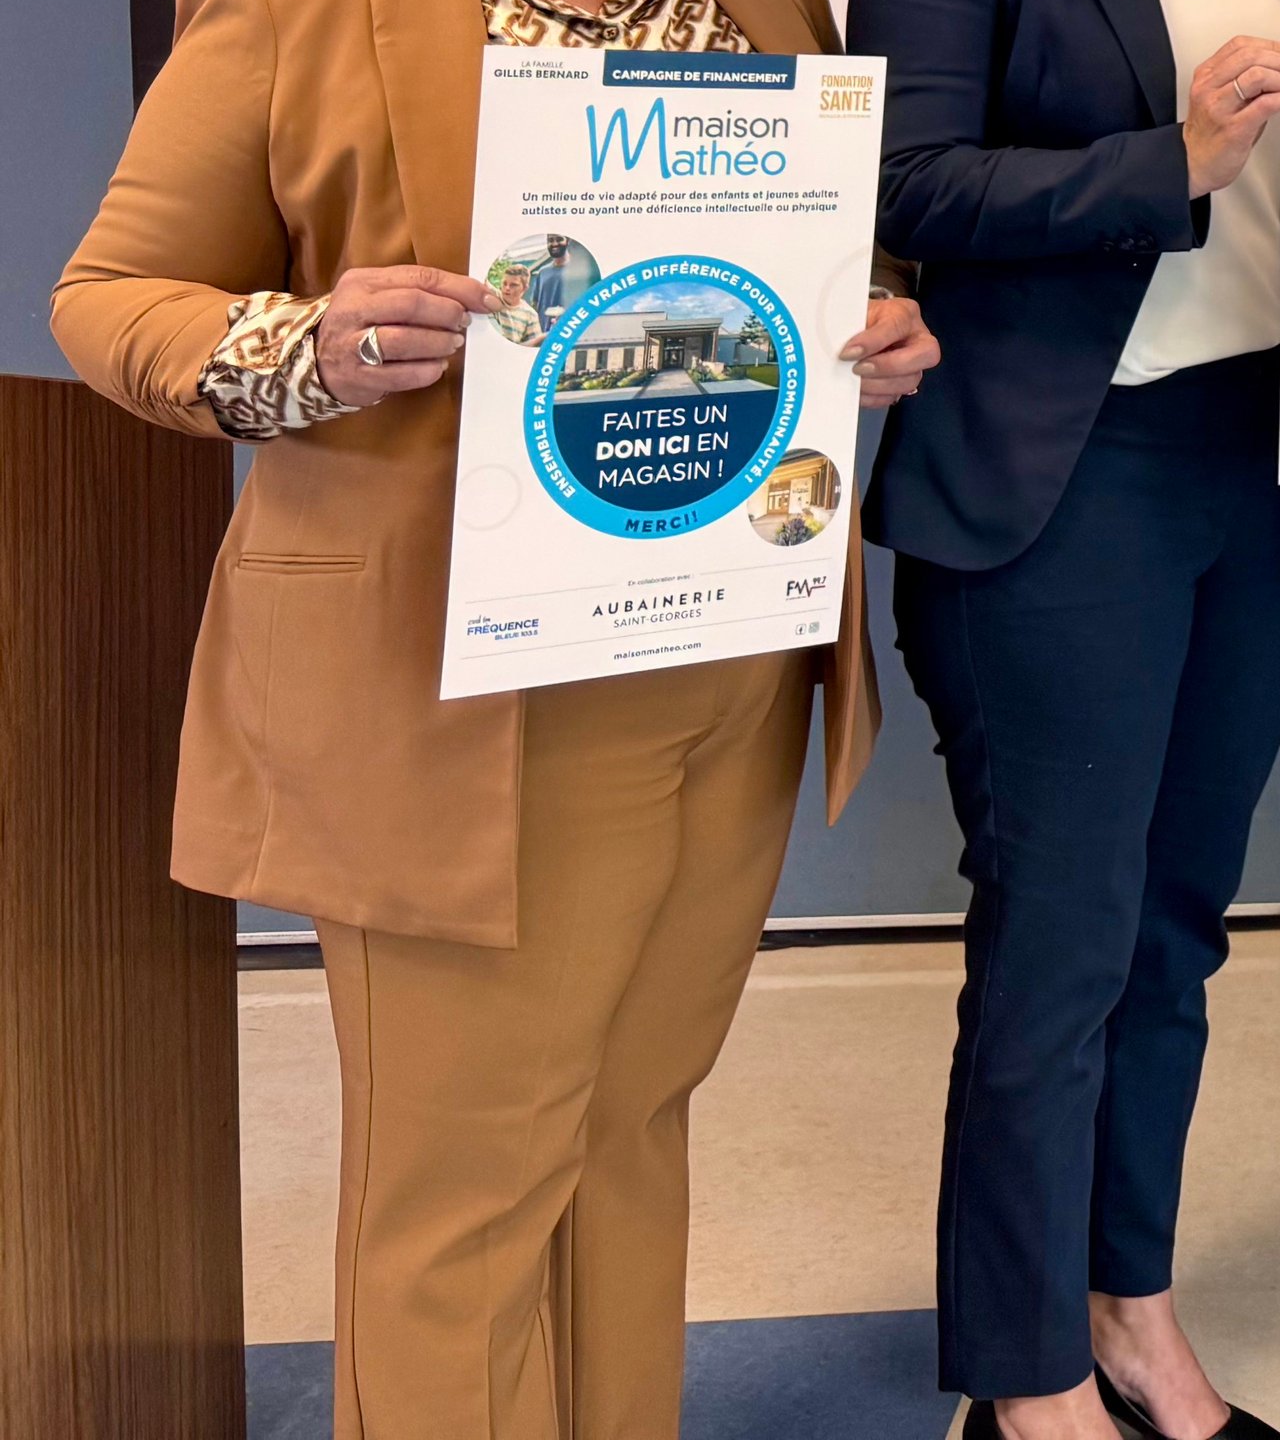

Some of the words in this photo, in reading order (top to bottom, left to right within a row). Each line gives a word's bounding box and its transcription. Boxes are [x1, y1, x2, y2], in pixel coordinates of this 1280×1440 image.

[494, 68, 532, 79] GILLES
[535, 69, 588, 80] BERNARD
[613, 69, 682, 81] CAMPAGNE
[685, 71, 700, 82] DE
[703, 72, 788, 83] FINANCEMENT
[821, 74, 874, 90] FONDATION
[820, 89, 872, 113] SANTÉ
[673, 110, 789, 139] maison
[586, 97, 786, 182] Mathéo
[641, 261, 740, 286] DIFFÉRENCE
[588, 272, 638, 309] VRAIE
[740, 282, 776, 315] POUR
[560, 306, 590, 342] UNE
[771, 312, 797, 365] NOTRE
[533, 352, 561, 415] FAISONS
[602, 408, 686, 433] FAITES
[693, 405, 728, 424] UN
[534, 418, 576, 499] ENSEMBLE
[596, 438, 652, 461] DON
[659, 436, 690, 456] ICI
[697, 432, 729, 452] EN
[598, 465, 711, 489] MAGASIN
[625, 511, 699, 533] MERCI!
[592, 589, 726, 618] AUBAINERIE
[466, 618, 539, 637] FRÉQUENCE
[613, 608, 702, 629] SAINT-GEORGES
[614, 641, 702, 661] maisonmatheo.com
